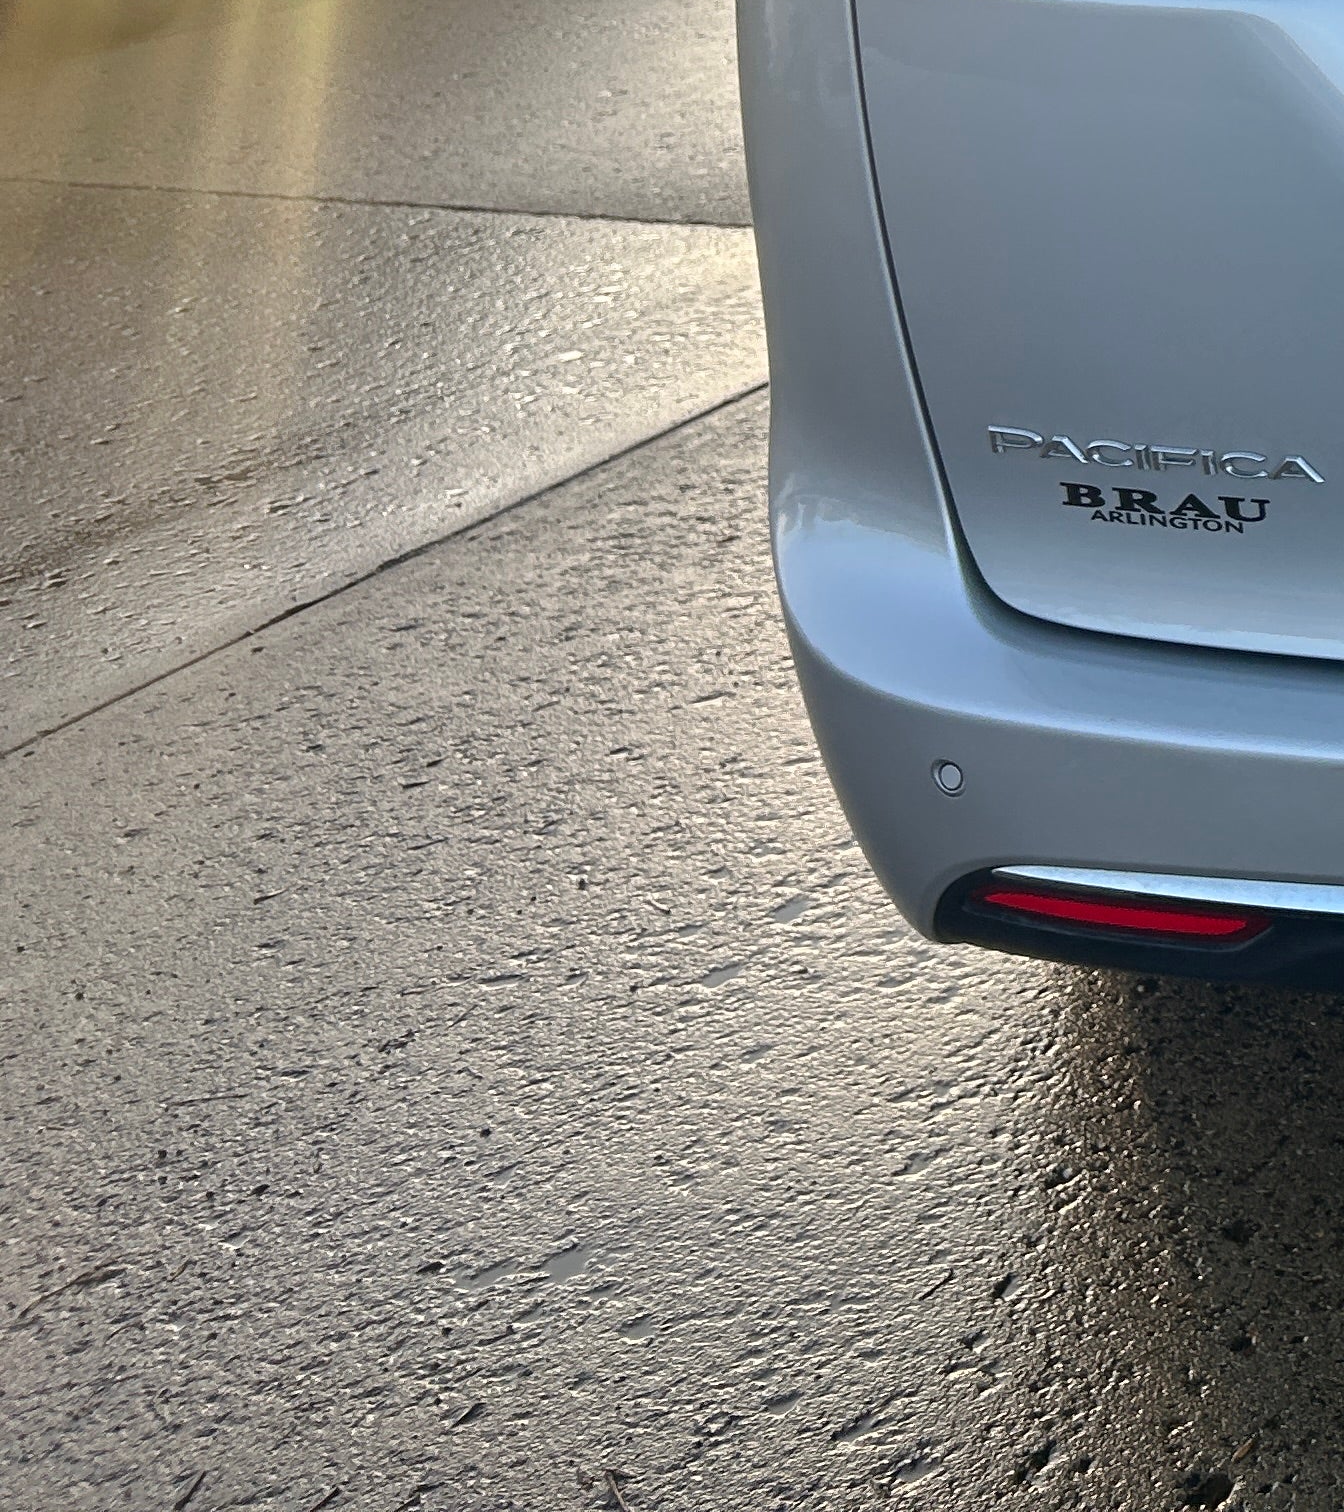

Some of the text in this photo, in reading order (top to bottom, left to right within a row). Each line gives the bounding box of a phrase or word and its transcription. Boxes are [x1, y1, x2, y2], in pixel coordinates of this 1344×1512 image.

[988, 424, 1326, 483] PACIFICA
[1060, 482, 1270, 523] BRAU
[1091, 509, 1244, 533] ARLINGTON
